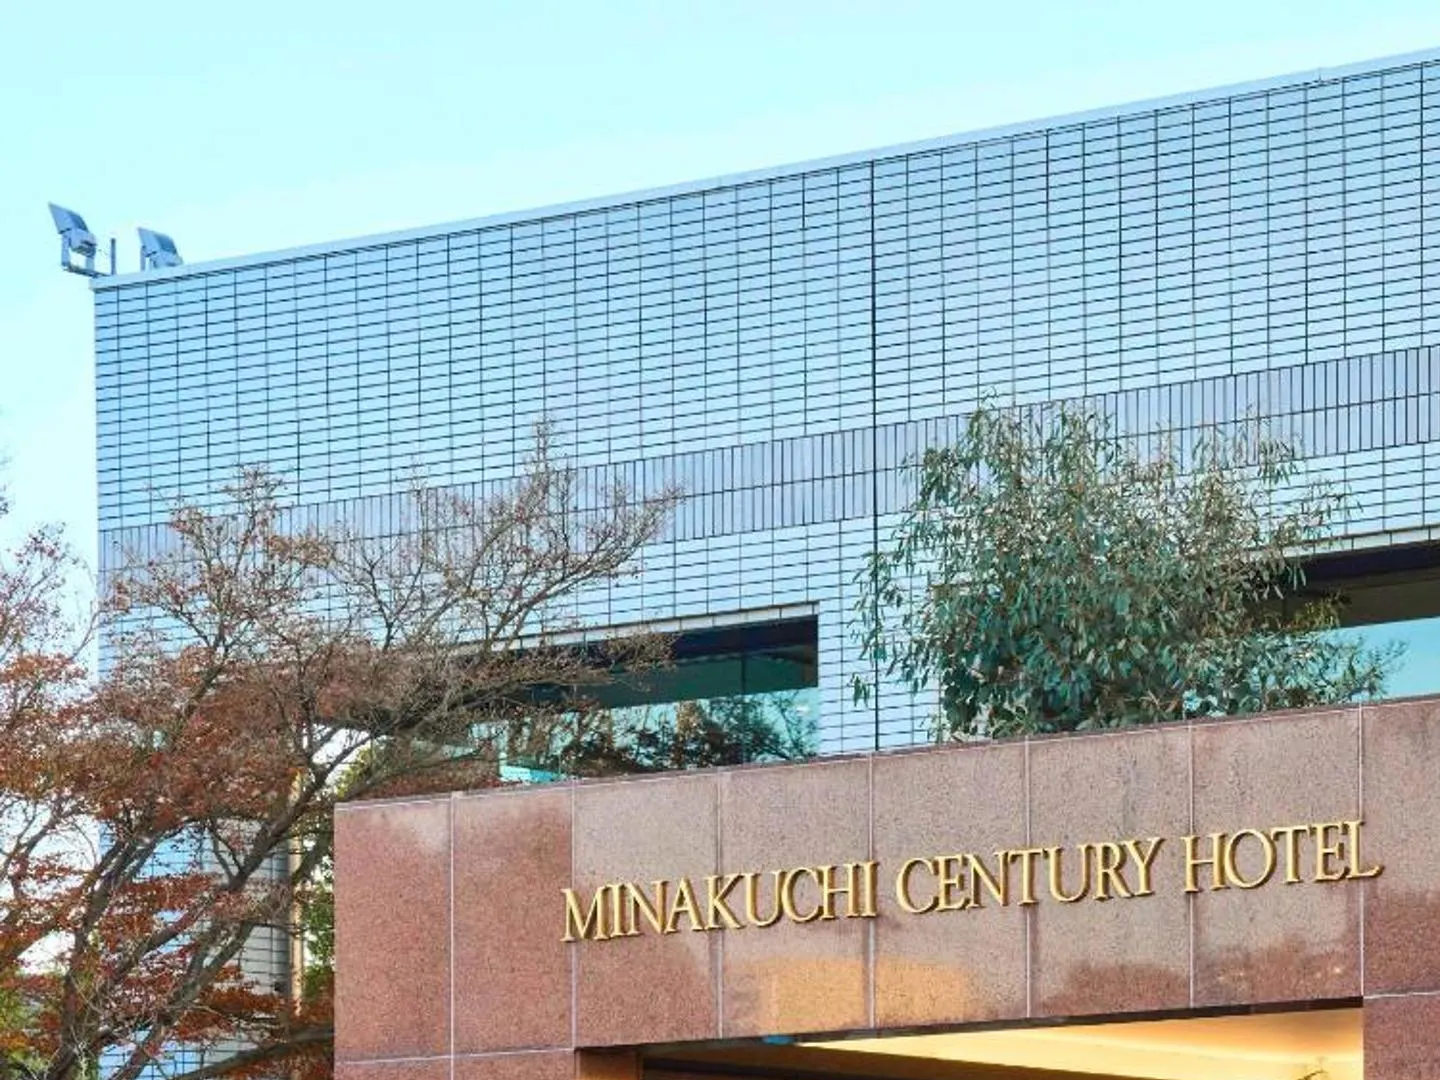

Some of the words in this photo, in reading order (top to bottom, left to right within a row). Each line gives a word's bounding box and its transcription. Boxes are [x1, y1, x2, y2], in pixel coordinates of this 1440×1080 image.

[560, 862, 878, 943] MINAKUCHI
[895, 838, 1165, 914] CENTURY
[1182, 819, 1383, 893] HOTEL
